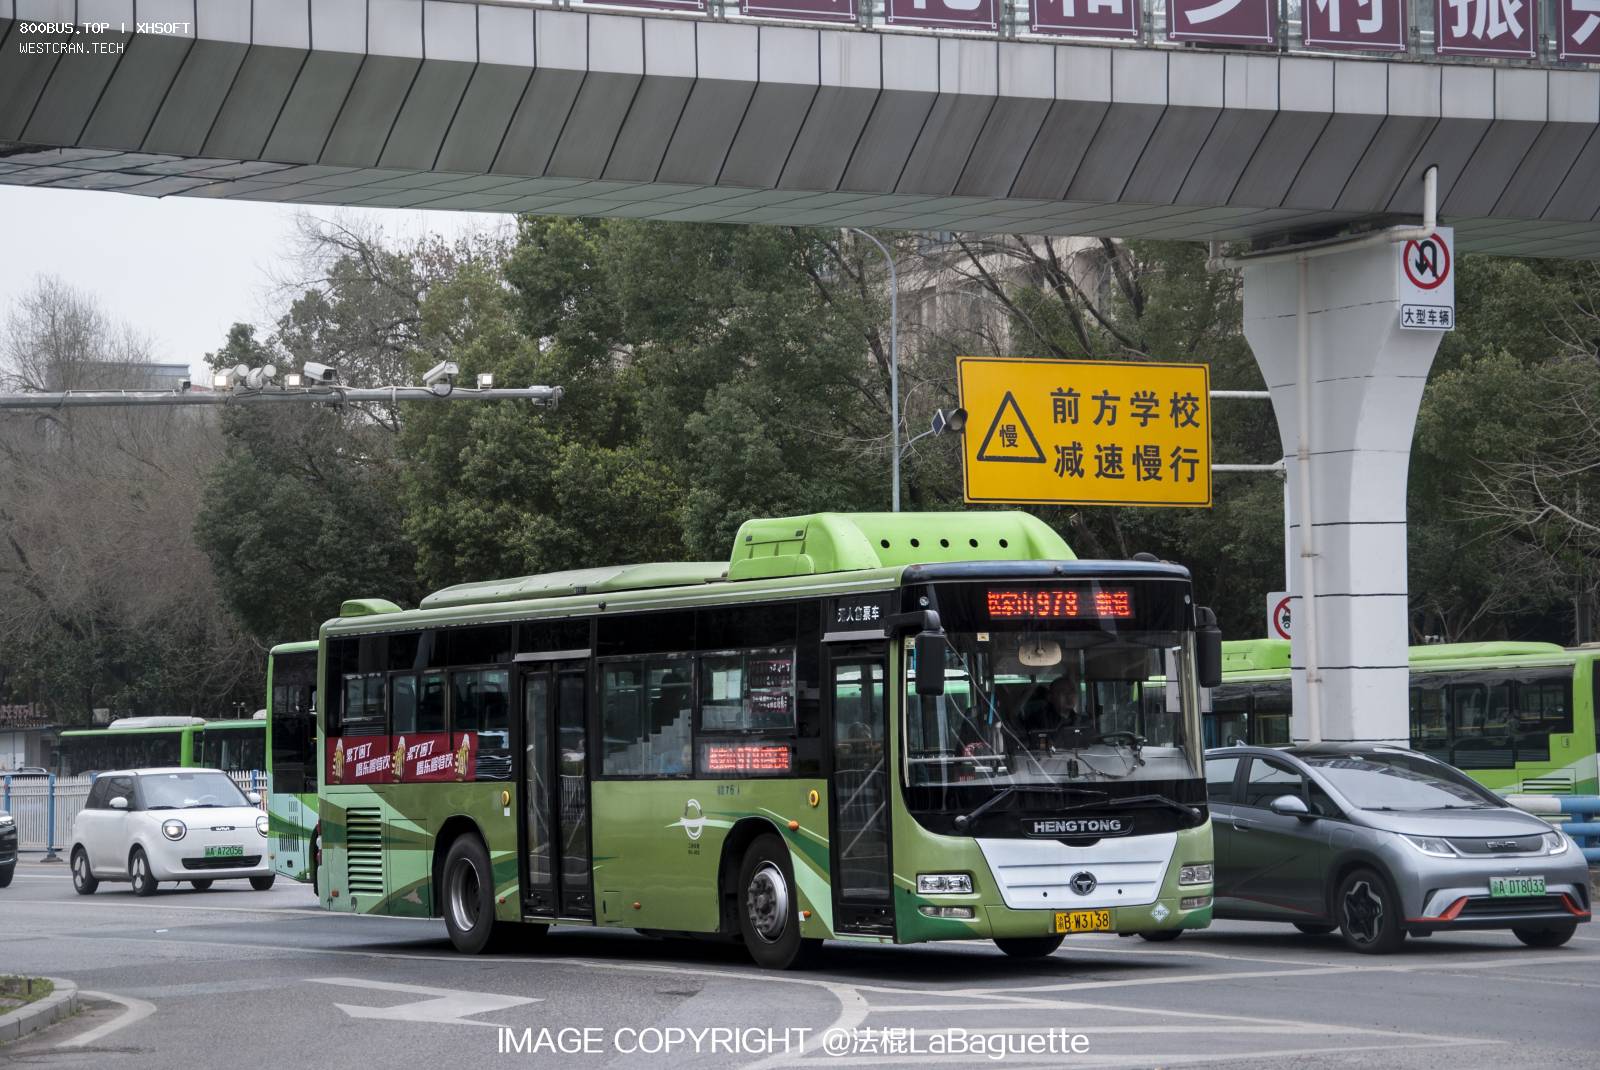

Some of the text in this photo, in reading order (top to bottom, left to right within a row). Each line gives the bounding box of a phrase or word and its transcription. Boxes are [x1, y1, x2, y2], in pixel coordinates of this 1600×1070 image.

[1404, 308, 1450, 326] 大型车辆
[1050, 387, 1200, 429] 前方学校
[999, 424, 1019, 448] 慢
[1053, 440, 1200, 483] 减速慢行
[1033, 818, 1122, 834] HENGTONG
